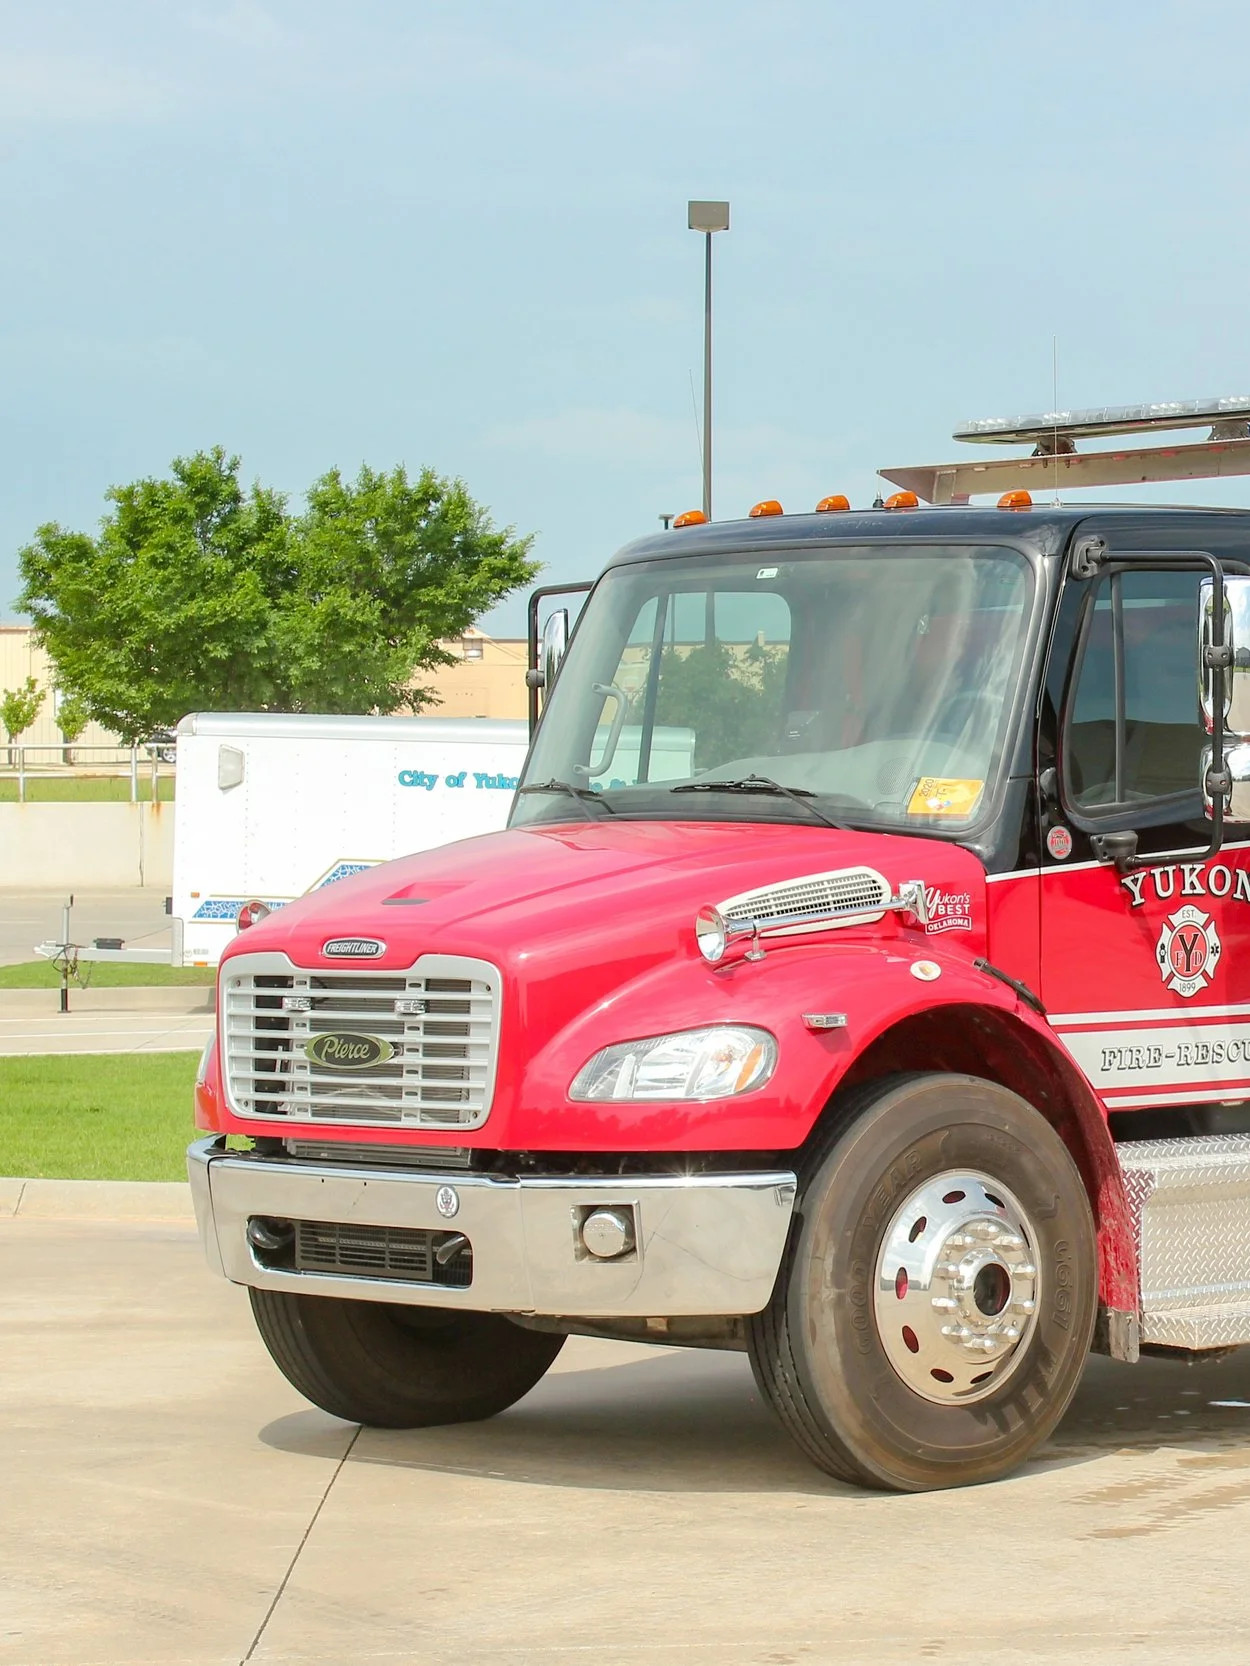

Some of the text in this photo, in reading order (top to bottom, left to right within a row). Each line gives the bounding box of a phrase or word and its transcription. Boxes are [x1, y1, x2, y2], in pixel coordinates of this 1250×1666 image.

[398, 769, 520, 791] City of Yuko
[925, 887, 970, 919] Yukon's
[938, 904, 970, 915] BEST
[928, 918, 969, 931] OKLAHOMA
[327, 942, 378, 953] FREIGHTLINER
[1179, 982, 1196, 992] 1899
[321, 1036, 371, 1061] Pierce
